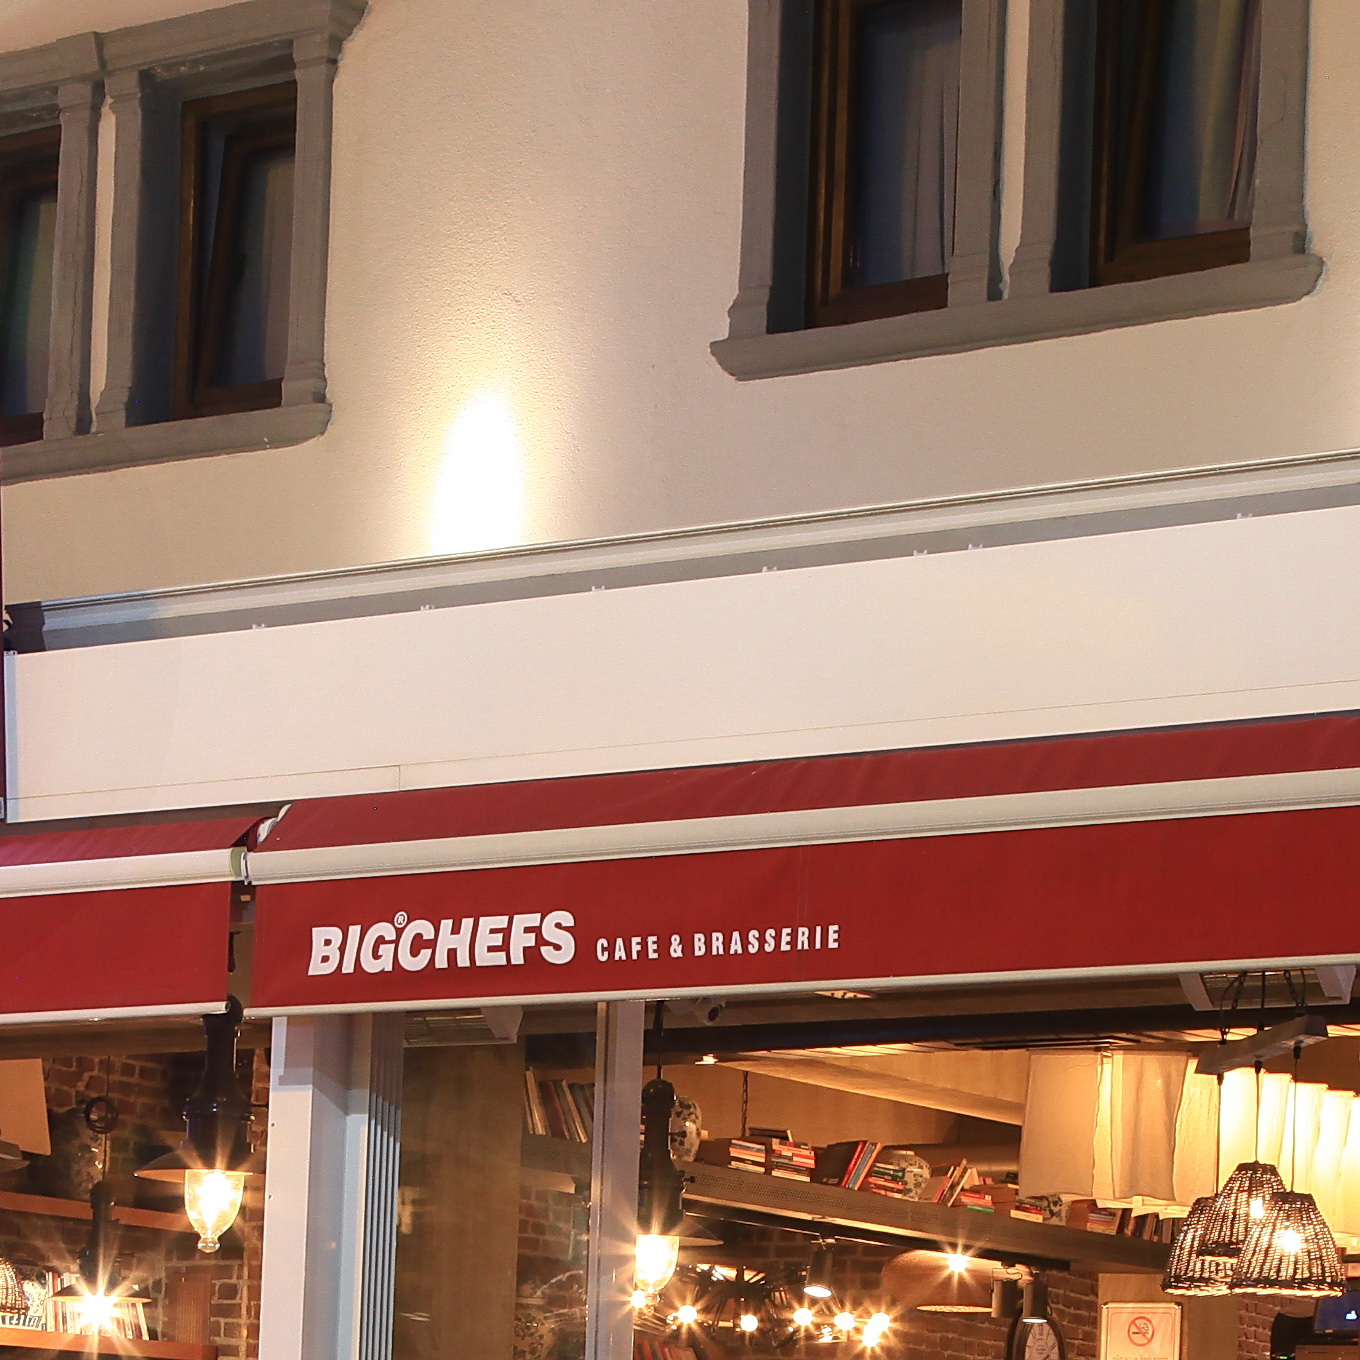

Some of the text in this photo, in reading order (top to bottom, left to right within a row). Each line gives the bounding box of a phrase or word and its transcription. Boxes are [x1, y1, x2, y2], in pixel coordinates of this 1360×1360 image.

[595, 936, 659, 961] CAFE
[670, 934, 683, 958] &
[693, 925, 840, 956] BRASSERIE
